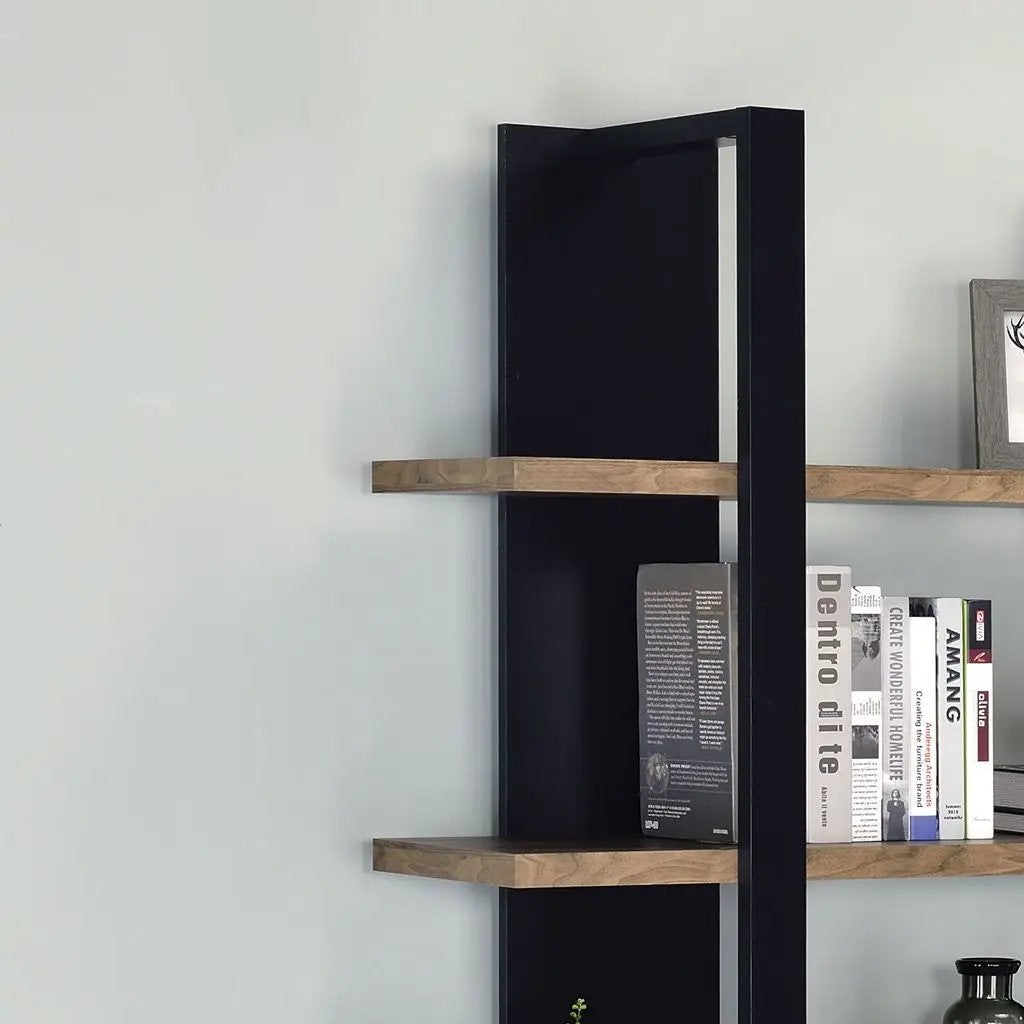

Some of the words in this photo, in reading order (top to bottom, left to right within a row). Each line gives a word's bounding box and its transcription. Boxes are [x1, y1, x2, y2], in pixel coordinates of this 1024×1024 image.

[817, 573, 841, 685] Dentro
[889, 607, 904, 647] CREATE
[889, 651, 904, 720] WONDERFUL
[945, 628, 961, 723] AMANG
[818, 701, 843, 732] di
[915, 690, 923, 727] Creating
[978, 693, 987, 727] olivia
[818, 743, 842, 774] te
[889, 725, 904, 781] HOMELIFE
[924, 722, 933, 763] Anderegg
[925, 766, 933, 807] Architects
